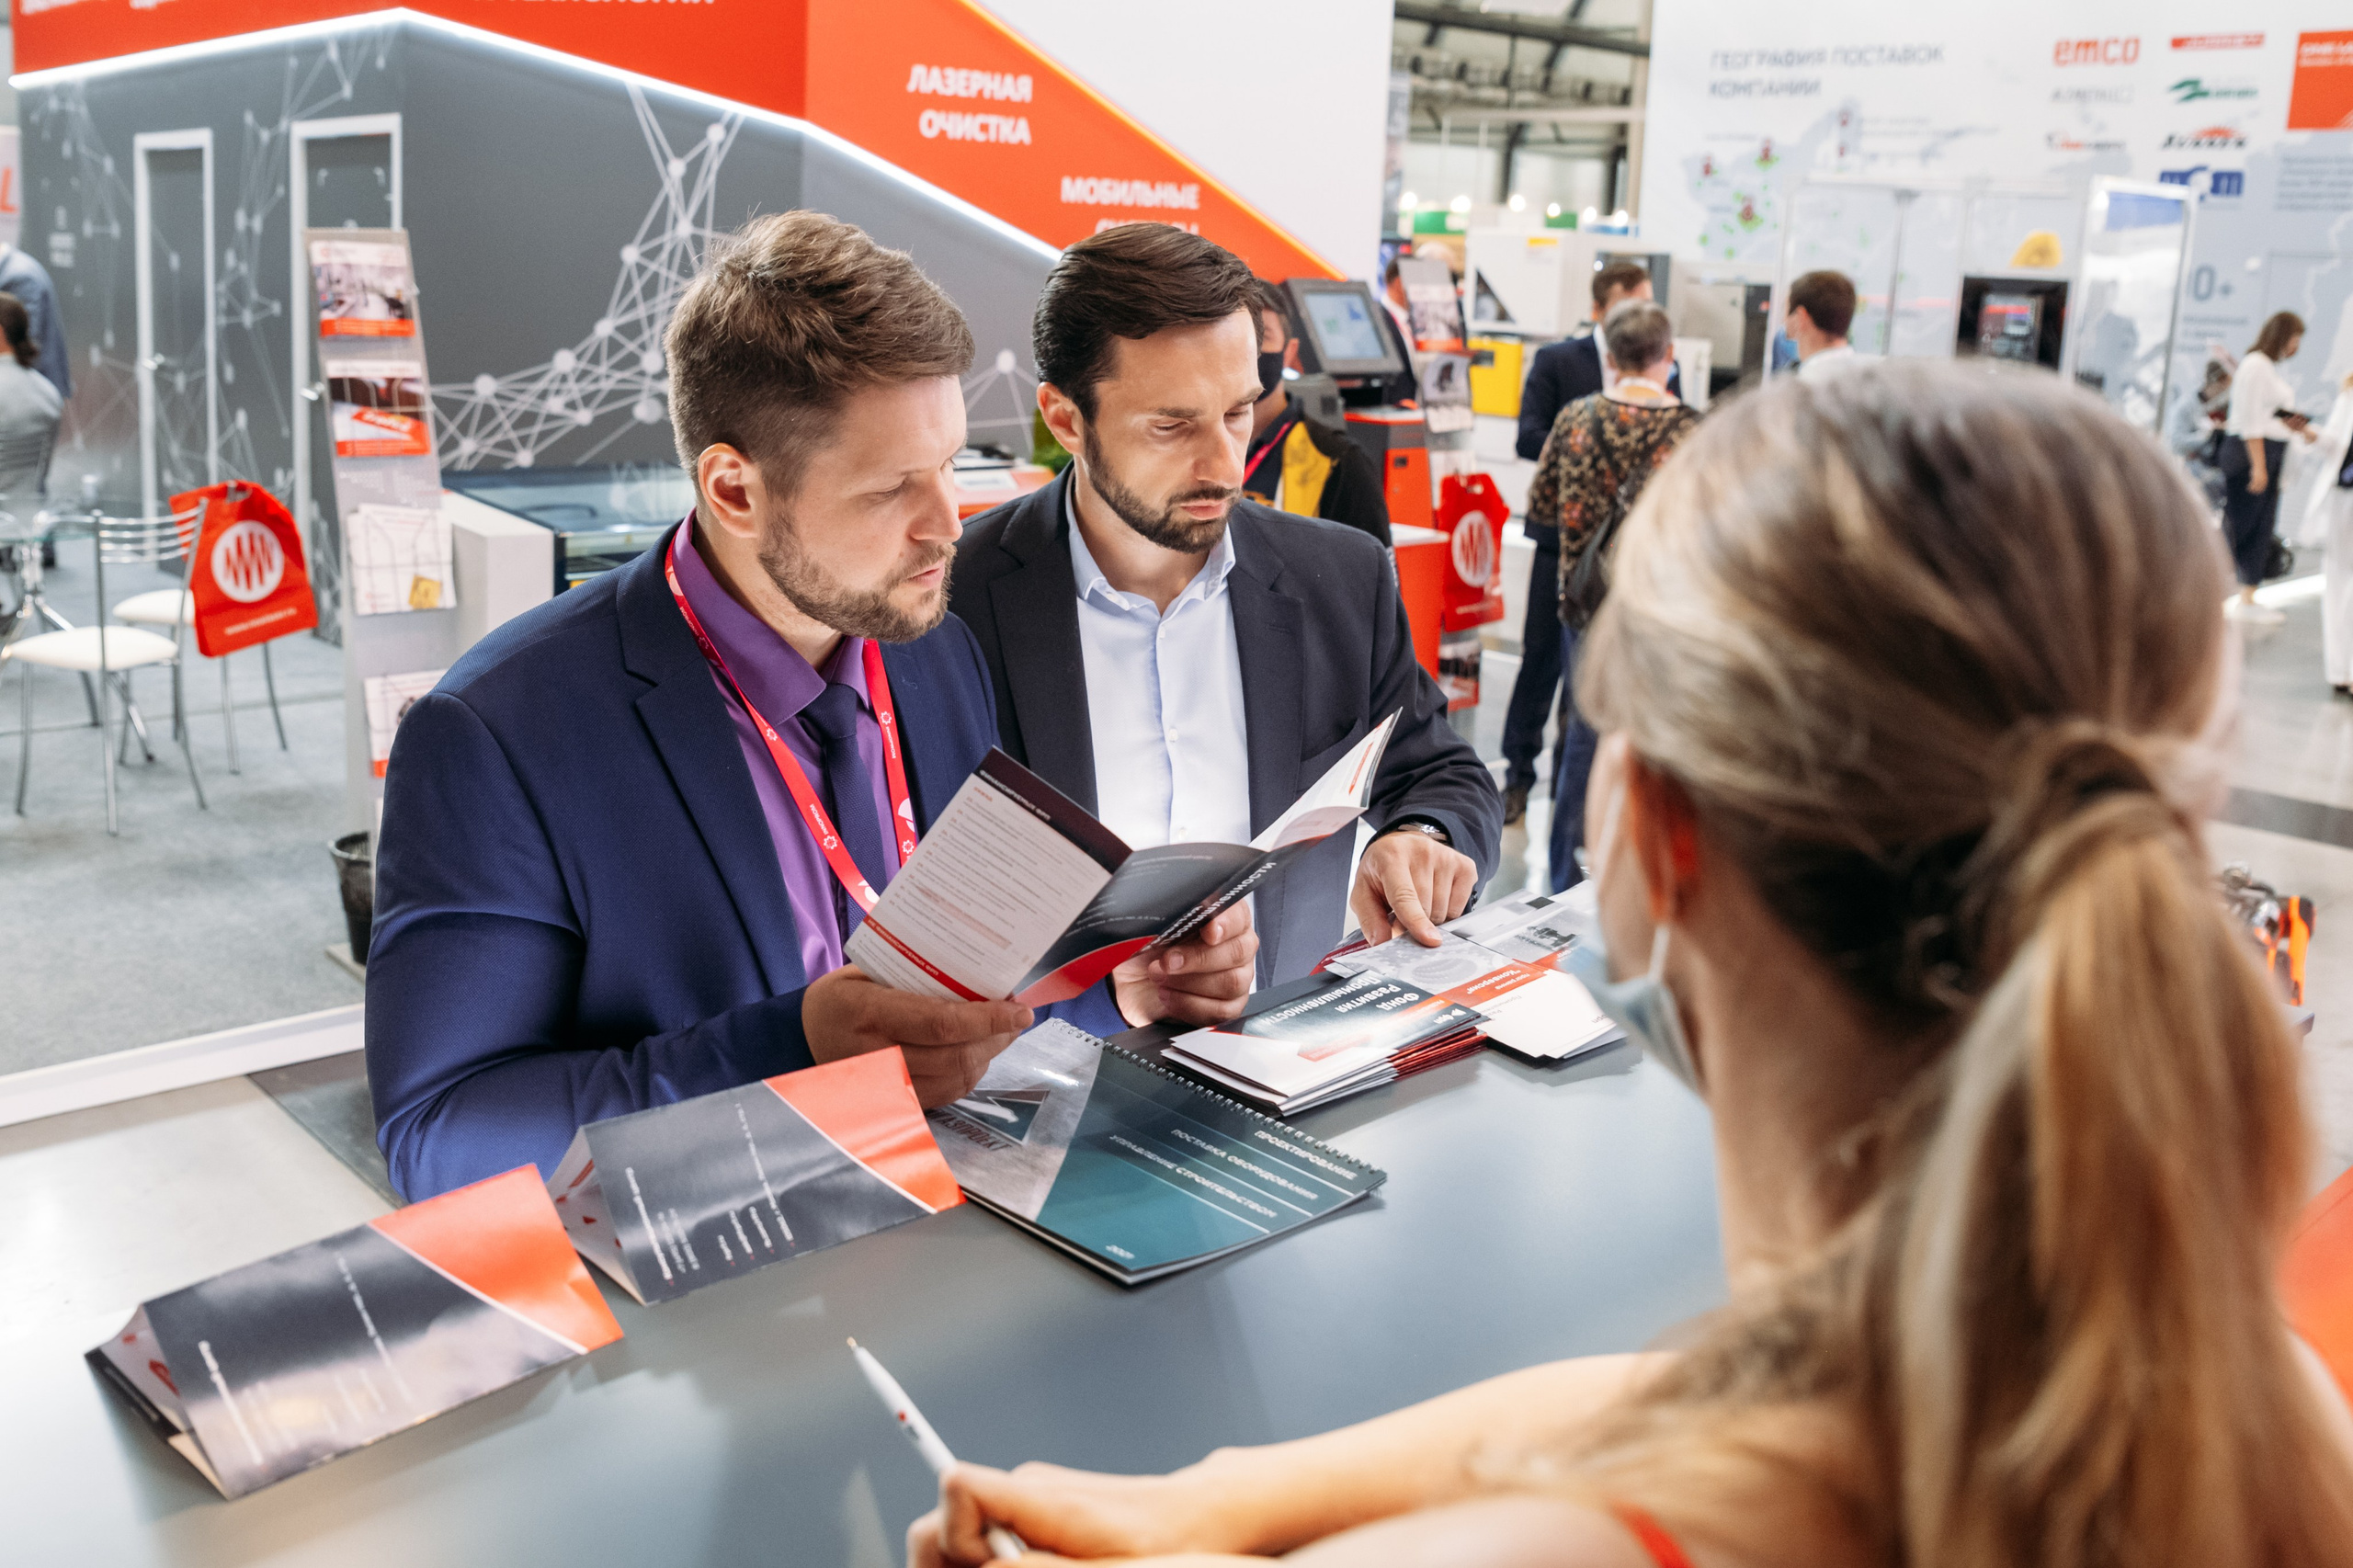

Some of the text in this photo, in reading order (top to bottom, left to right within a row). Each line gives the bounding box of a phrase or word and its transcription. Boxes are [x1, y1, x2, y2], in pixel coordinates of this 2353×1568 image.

[2053, 37, 2140, 66] emco
[906, 64, 1033, 103] ЛАЗЕРНАЯ
[919, 109, 1031, 145] ОЧИСТКА
[1061, 176, 1200, 210] МОБИЛЬНЫЕ
[886, 726, 896, 759] INNOPROM
[810, 803, 829, 835] INNOPROM
[1260, 976, 1381, 1025] Промышленности
[1335, 983, 1403, 1014] Развития
[1376, 992, 1420, 1012] Фонд
[1170, 1129, 1318, 1200] ПОСТАВКА ОБОРУДОВАНИЯ
[1255, 1130, 1358, 1181] ПРОЕКТИРОВАНИЕ
[1109, 1134, 1279, 1218] УПРАВЛЕНИЕ СТРОИТЕЛЬСТВОМ
